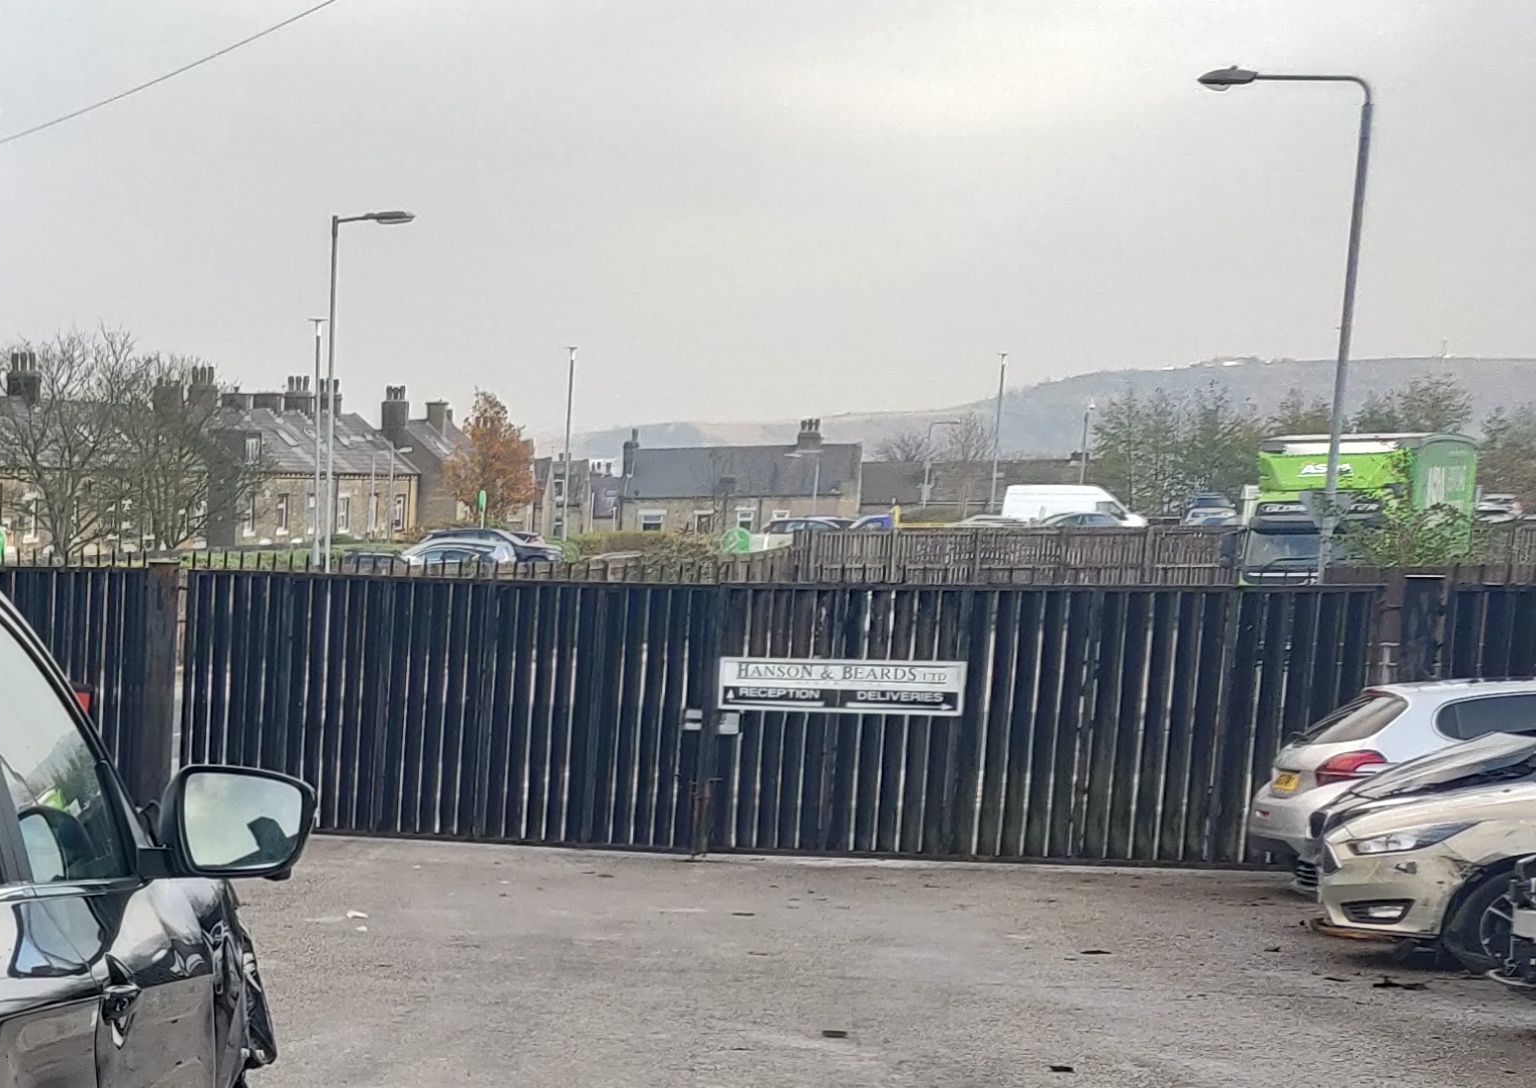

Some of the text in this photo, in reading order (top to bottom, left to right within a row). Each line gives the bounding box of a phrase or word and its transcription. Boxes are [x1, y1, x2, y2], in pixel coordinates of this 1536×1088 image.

[1299, 463, 1353, 475] ASA
[737, 662, 813, 679] HANSON
[820, 665, 834, 680] &
[842, 665, 917, 682] BEARDS
[739, 687, 820, 699] RECEPTION
[856, 690, 944, 703] DELIVERIES
